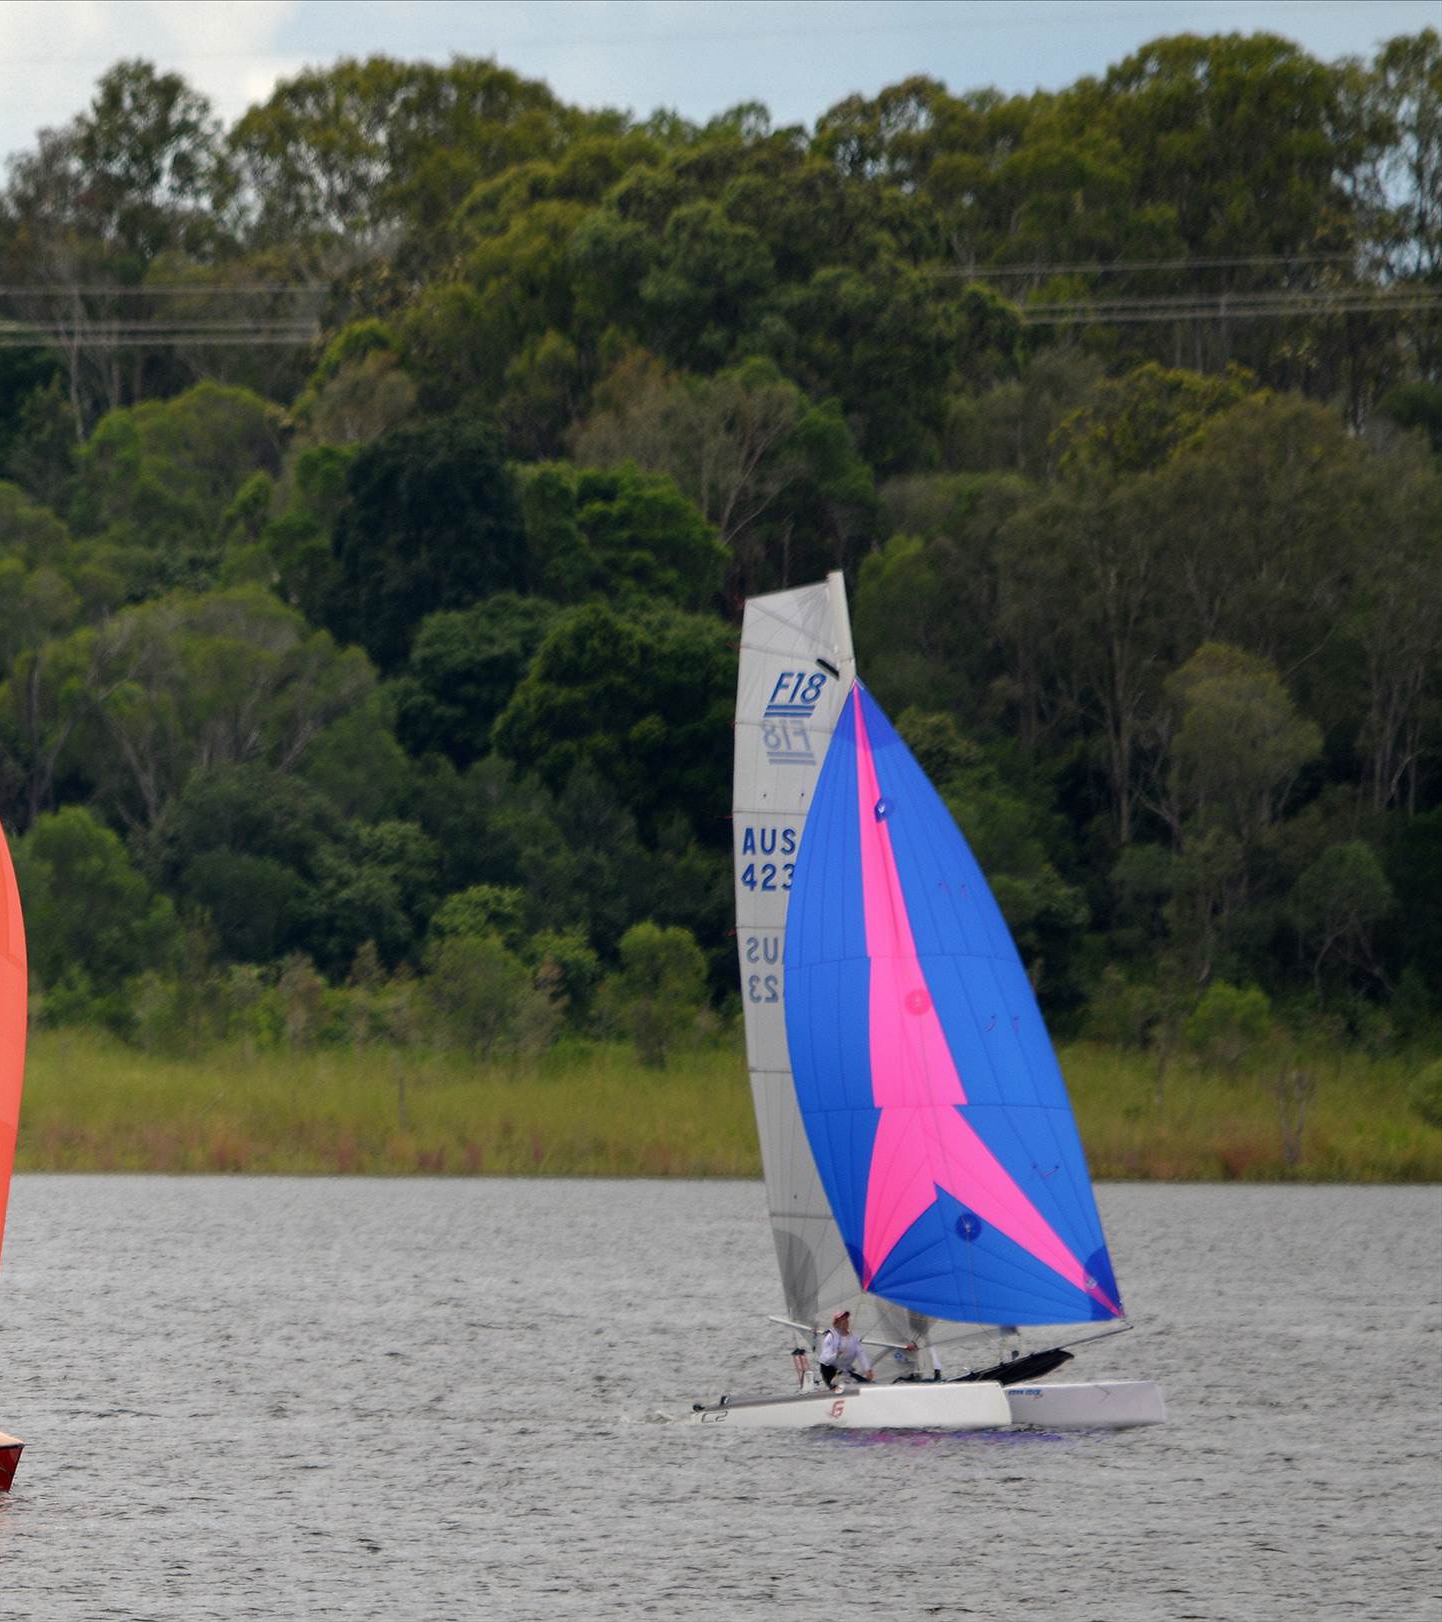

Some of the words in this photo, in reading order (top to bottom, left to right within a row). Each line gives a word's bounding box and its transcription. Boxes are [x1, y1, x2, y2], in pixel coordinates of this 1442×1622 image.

[769, 671, 826, 704] F18
[742, 827, 796, 856] AUS
[741, 863, 795, 892] 423
